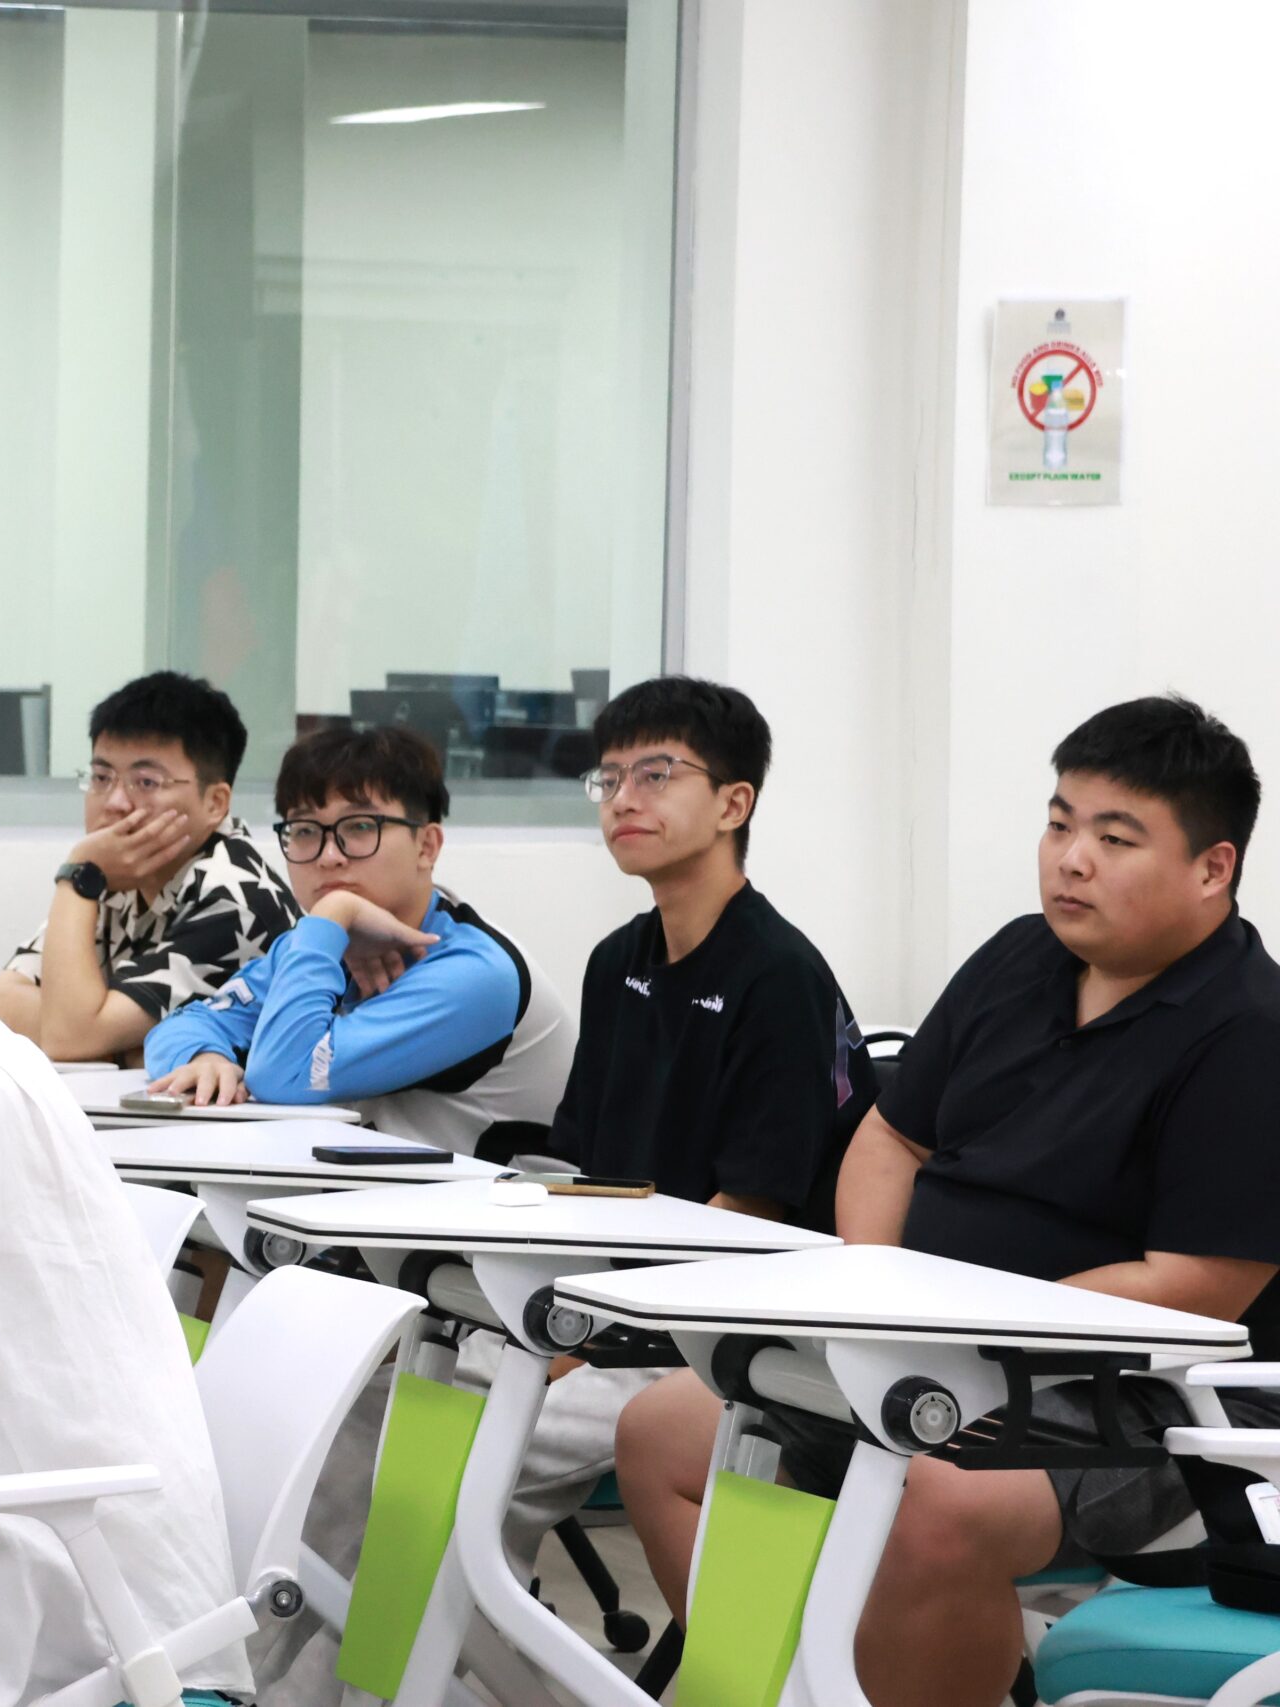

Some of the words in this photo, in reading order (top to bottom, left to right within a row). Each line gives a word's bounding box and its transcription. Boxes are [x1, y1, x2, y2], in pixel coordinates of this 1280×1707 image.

[1009, 472, 1041, 481] EXCEPT
[1042, 472, 1069, 481] PLAIN
[1070, 472, 1101, 481] WATER
